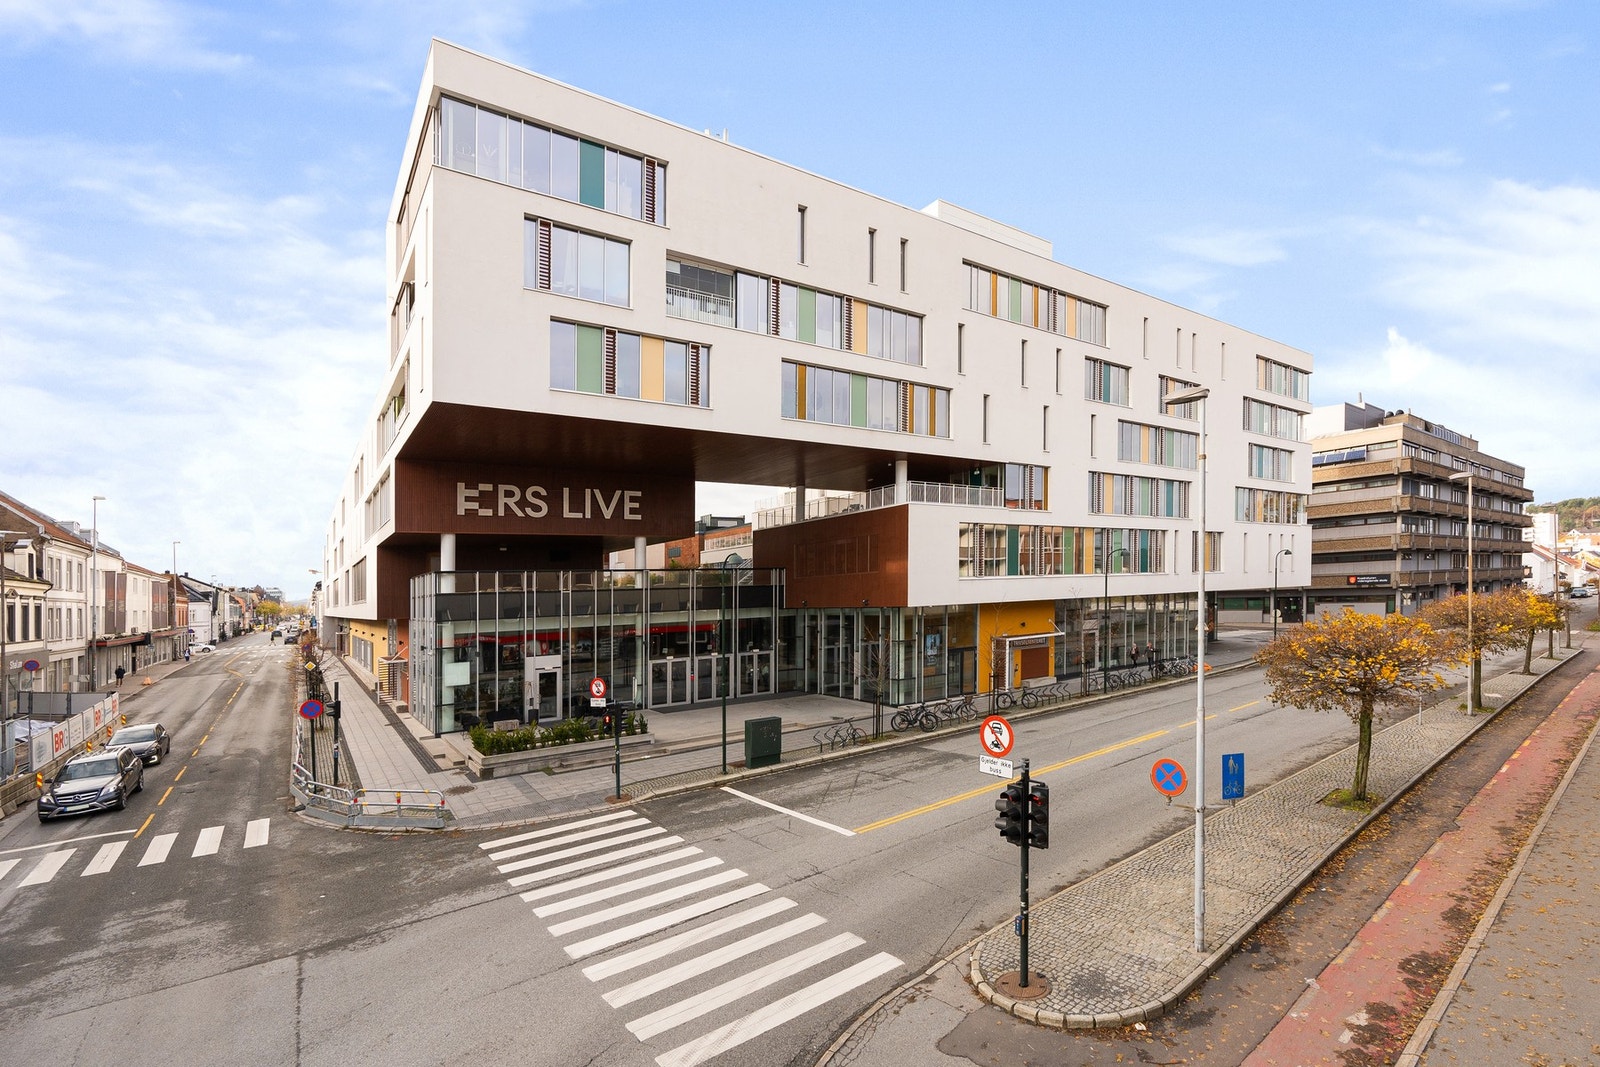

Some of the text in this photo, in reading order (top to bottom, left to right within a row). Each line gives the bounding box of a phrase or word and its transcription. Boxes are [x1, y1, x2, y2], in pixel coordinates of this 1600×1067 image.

[563, 487, 642, 520] LIVE
[980, 756, 1012, 769] Gjelder ikke
[989, 766, 1002, 774] buss
